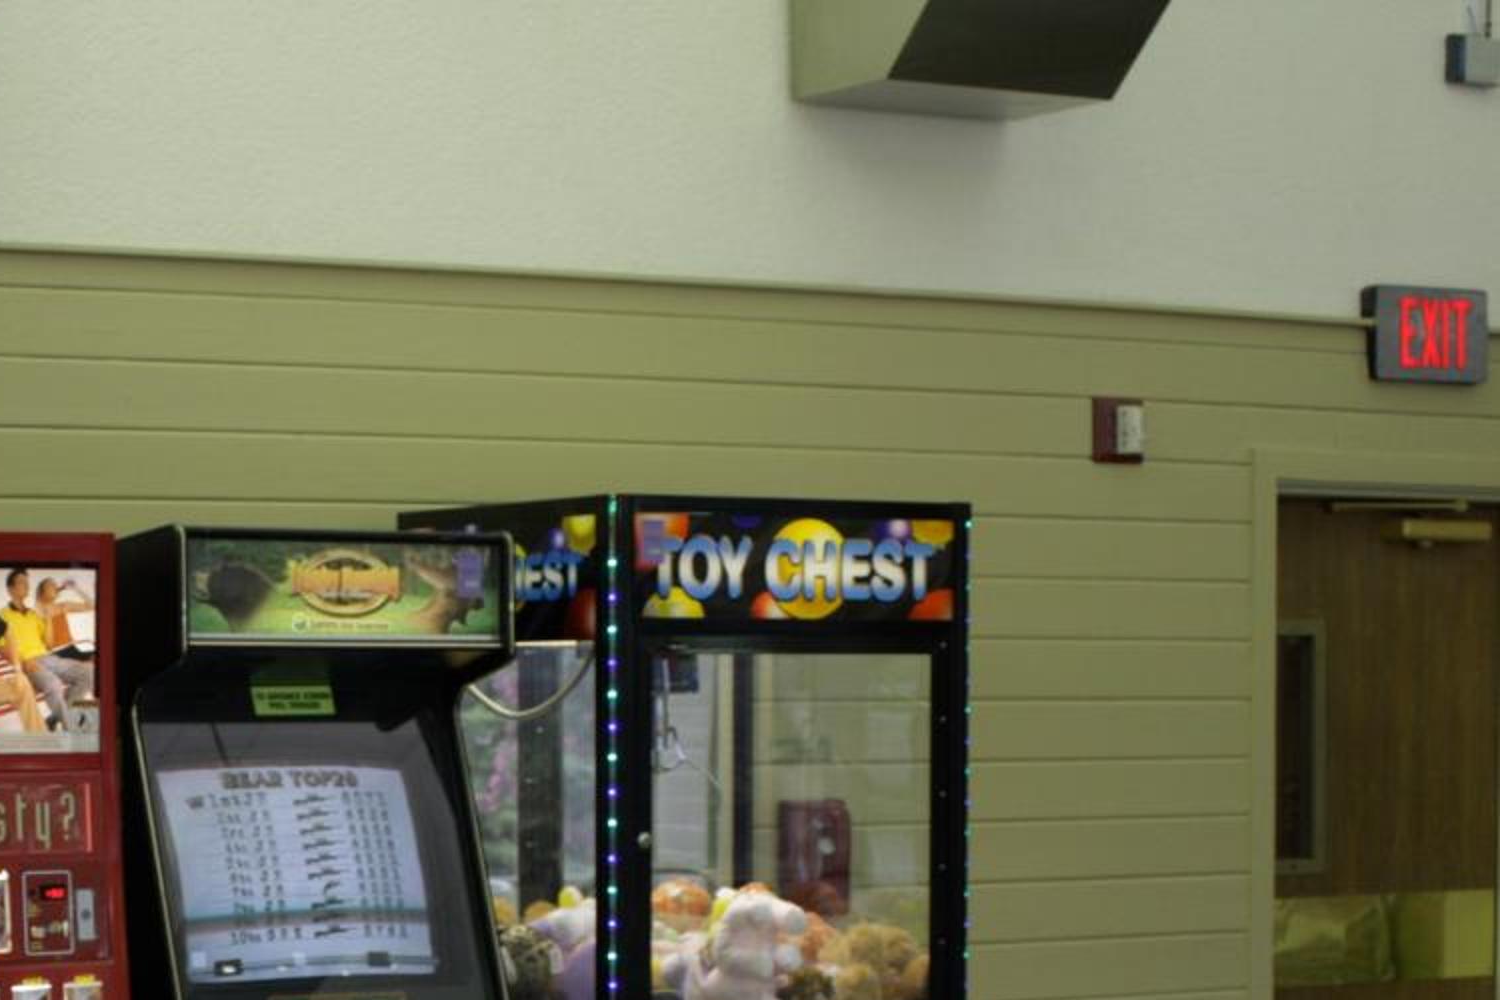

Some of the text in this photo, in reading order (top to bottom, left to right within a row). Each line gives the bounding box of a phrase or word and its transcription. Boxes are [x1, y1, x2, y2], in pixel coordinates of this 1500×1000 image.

[1398, 296, 1474, 371] EXIT
[515, 551, 581, 602] EST
[653, 534, 936, 602] TOY CHEST
